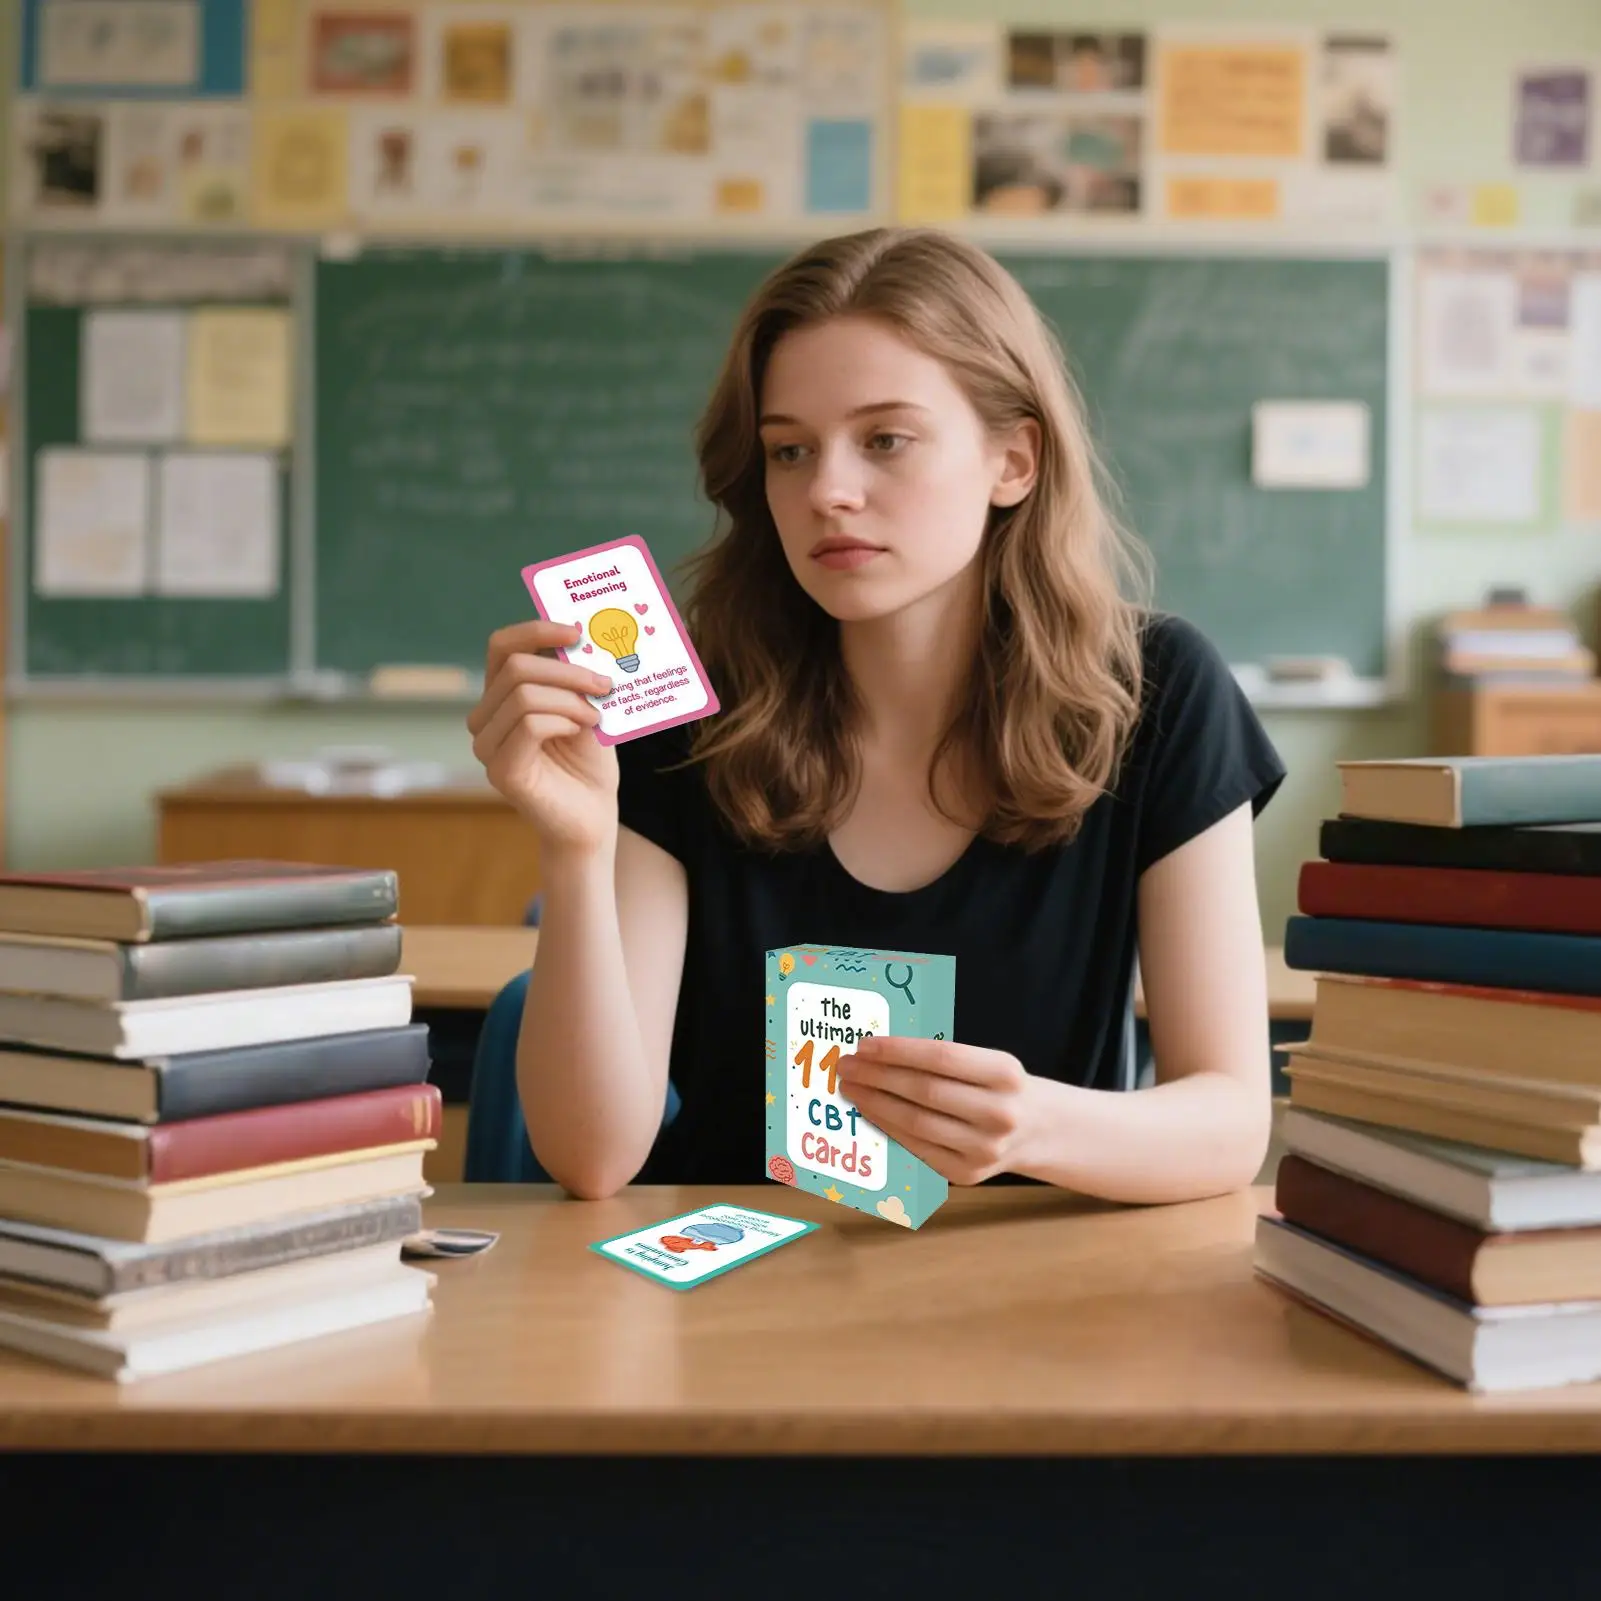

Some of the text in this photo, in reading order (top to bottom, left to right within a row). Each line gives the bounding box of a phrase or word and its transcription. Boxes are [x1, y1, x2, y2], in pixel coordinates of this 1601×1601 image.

[563, 565, 621, 589] Emotional
[570, 581, 627, 603] Reasoning
[634, 675, 652, 687] that
[653, 665, 688, 681] feelings
[602, 677, 690, 710] are facts, regardless
[624, 695, 678, 715] of evidence.
[794, 1040, 841, 1094] 11
